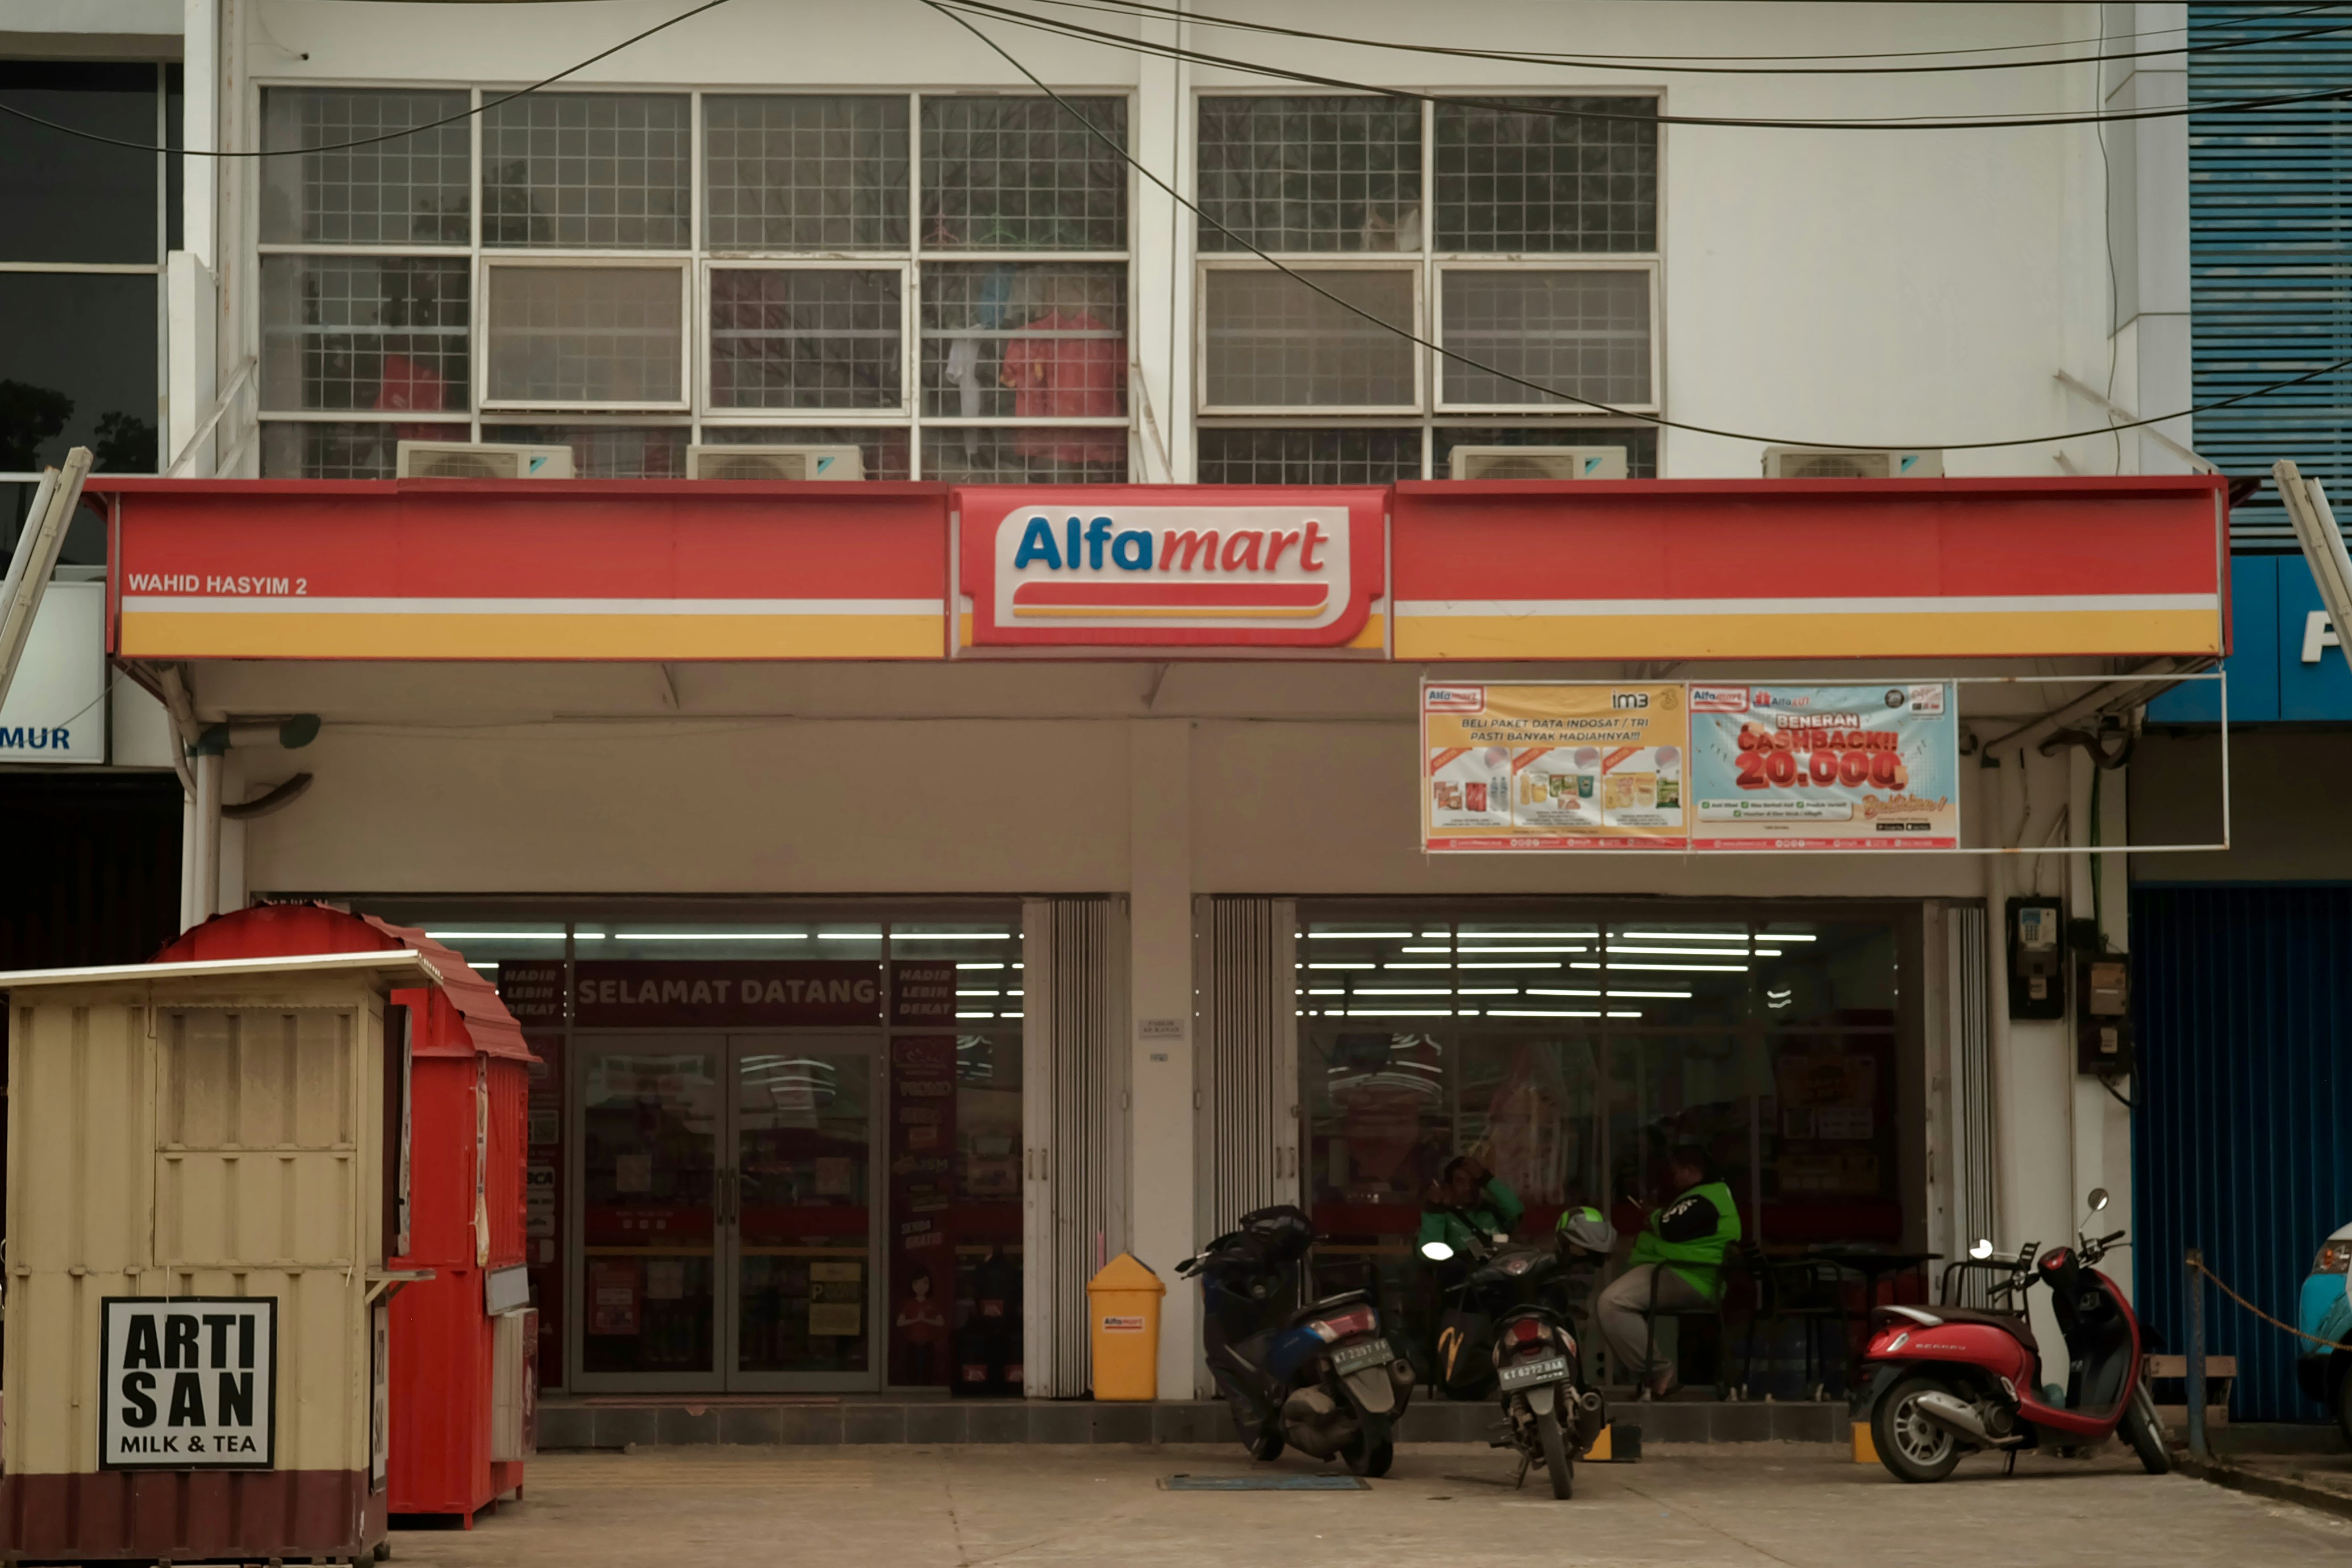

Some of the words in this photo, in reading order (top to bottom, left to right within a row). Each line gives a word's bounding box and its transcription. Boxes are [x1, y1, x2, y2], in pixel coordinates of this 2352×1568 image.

[1013, 516, 1328, 572] Alfamart
[128, 573, 200, 592] WAHID
[206, 575, 289, 595] HASYIM
[295, 578, 307, 595] 2
[1612, 690, 1649, 708] im3
[1462, 719, 1487, 728] BELI
[1491, 719, 1528, 728] PAKET
[1532, 719, 1563, 728] DATA
[1566, 719, 1619, 728] INDOSAT
[1630, 719, 1649, 727] TRI
[1776, 714, 1860, 729] BENERAN
[0, 727, 70, 749] MUR
[1470, 732, 1504, 741] PASTI
[1507, 732, 1555, 741] BANYAK
[1559, 732, 1641, 741] HADIAHNYA!!!
[1738, 730, 1899, 752] CASHBACK!!
[1735, 751, 1908, 791] 20.000
[504, 970, 556, 981] HADIR
[899, 969, 952, 981] HADIR
[507, 987, 554, 998] LEBIH
[578, 980, 732, 1004] SELAMAT
[741, 979, 876, 1004] DATANG
[902, 986, 949, 998] LEBIH
[899, 1003, 951, 1015] DEKAT
[123, 1314, 256, 1369] ARTI
[122, 1371, 253, 1428] SAN
[120, 1436, 179, 1453] MILK
[187, 1436, 206, 1453] &
[214, 1436, 257, 1453] TEA
